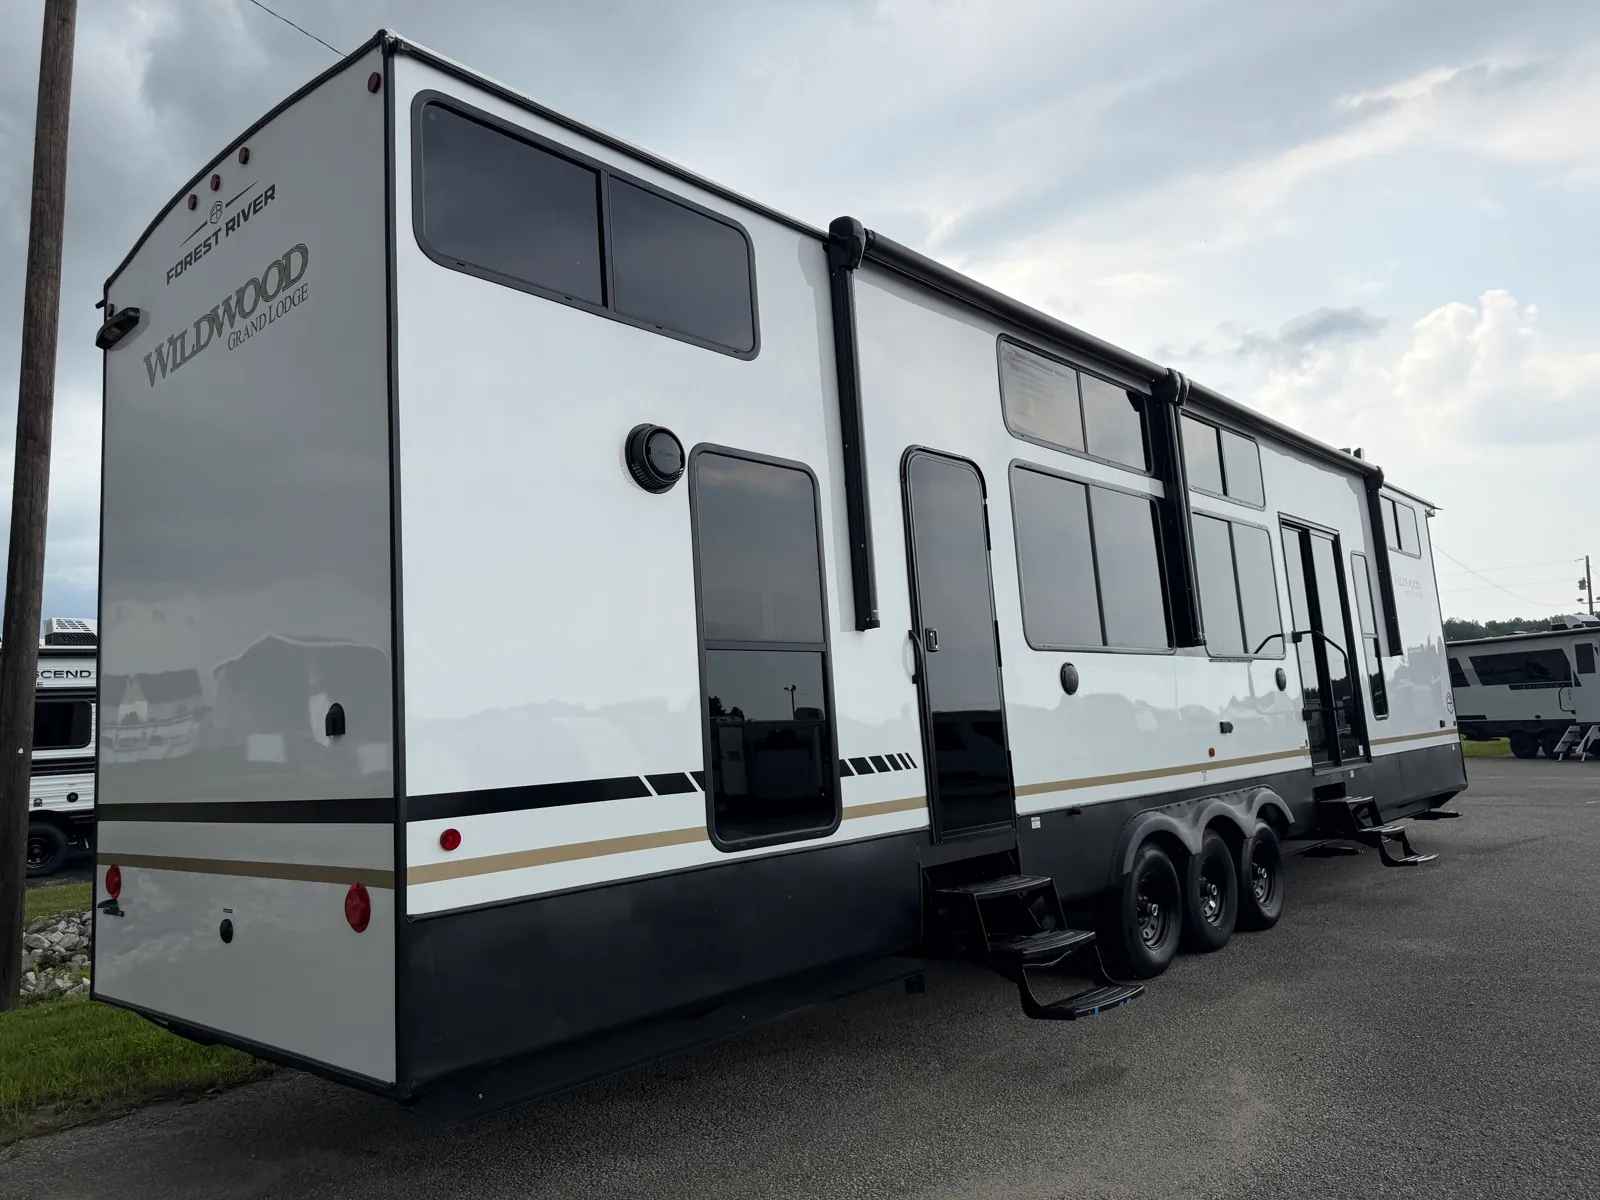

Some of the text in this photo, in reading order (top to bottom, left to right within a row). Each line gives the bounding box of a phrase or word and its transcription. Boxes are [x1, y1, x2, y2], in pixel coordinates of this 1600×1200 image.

[166, 183, 276, 286] FOREST RIVER
[143, 243, 309, 388] WILDWOOD
[227, 283, 309, 351] GRAND LODGE
